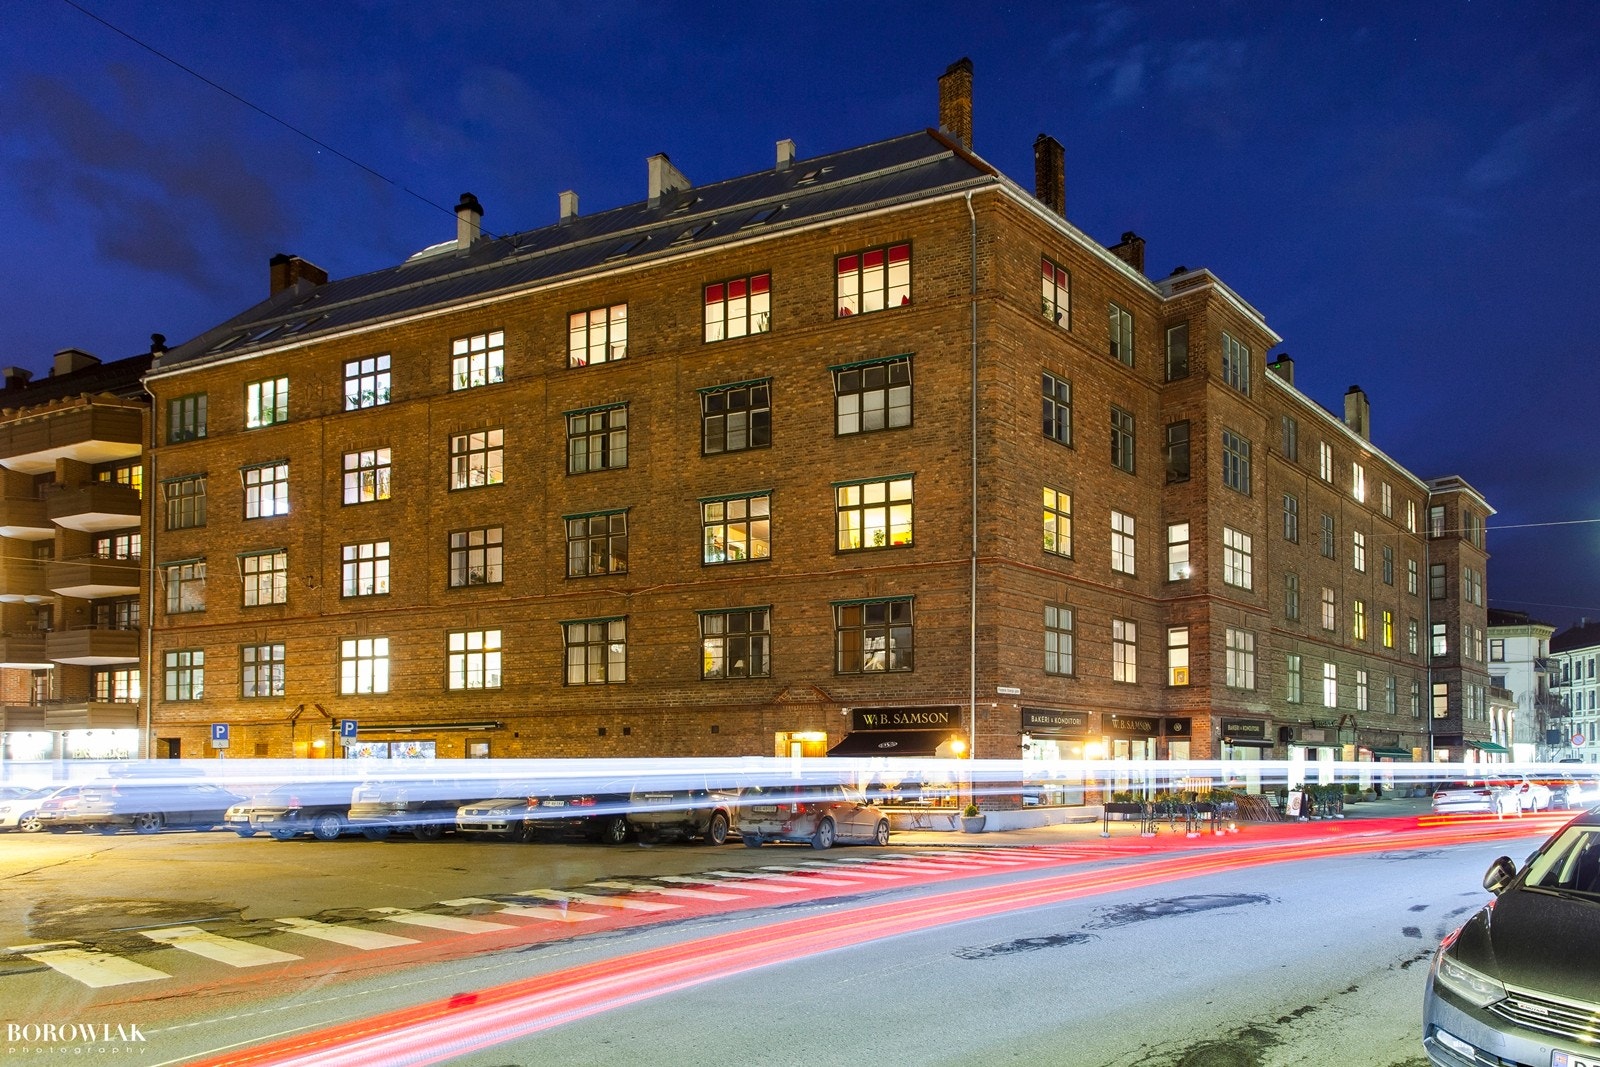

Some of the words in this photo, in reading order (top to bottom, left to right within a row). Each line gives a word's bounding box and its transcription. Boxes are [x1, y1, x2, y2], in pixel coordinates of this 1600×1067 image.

[893, 712, 949, 724] SAMSON
[1031, 715, 1049, 723] BAKERI
[1054, 717, 1082, 725] KONDITORI
[345, 722, 355, 736] P
[1126, 720, 1152, 731] SAMSON
[216, 725, 226, 739] P
